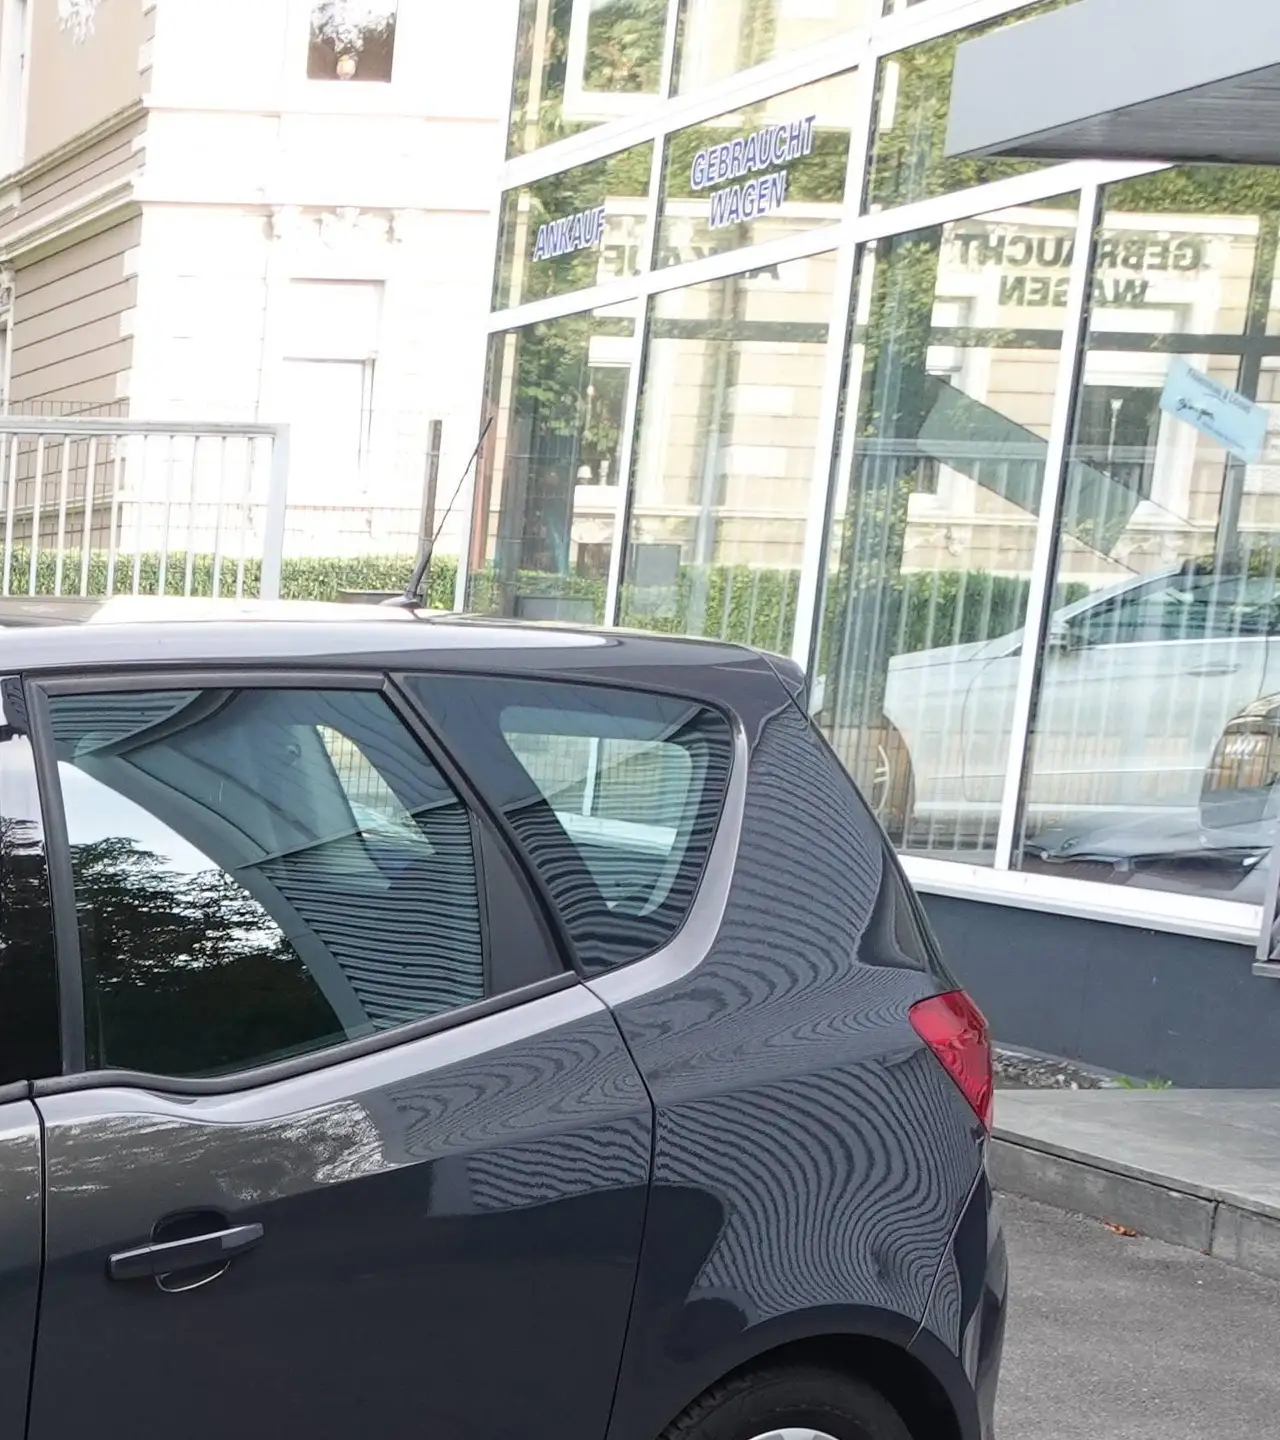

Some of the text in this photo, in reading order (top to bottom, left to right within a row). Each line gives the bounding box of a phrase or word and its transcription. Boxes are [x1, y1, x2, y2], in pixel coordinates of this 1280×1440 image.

[691, 115, 816, 190] GEBRAUCHT
[708, 170, 787, 231] WAGEN
[532, 207, 606, 262] ANKAUF
